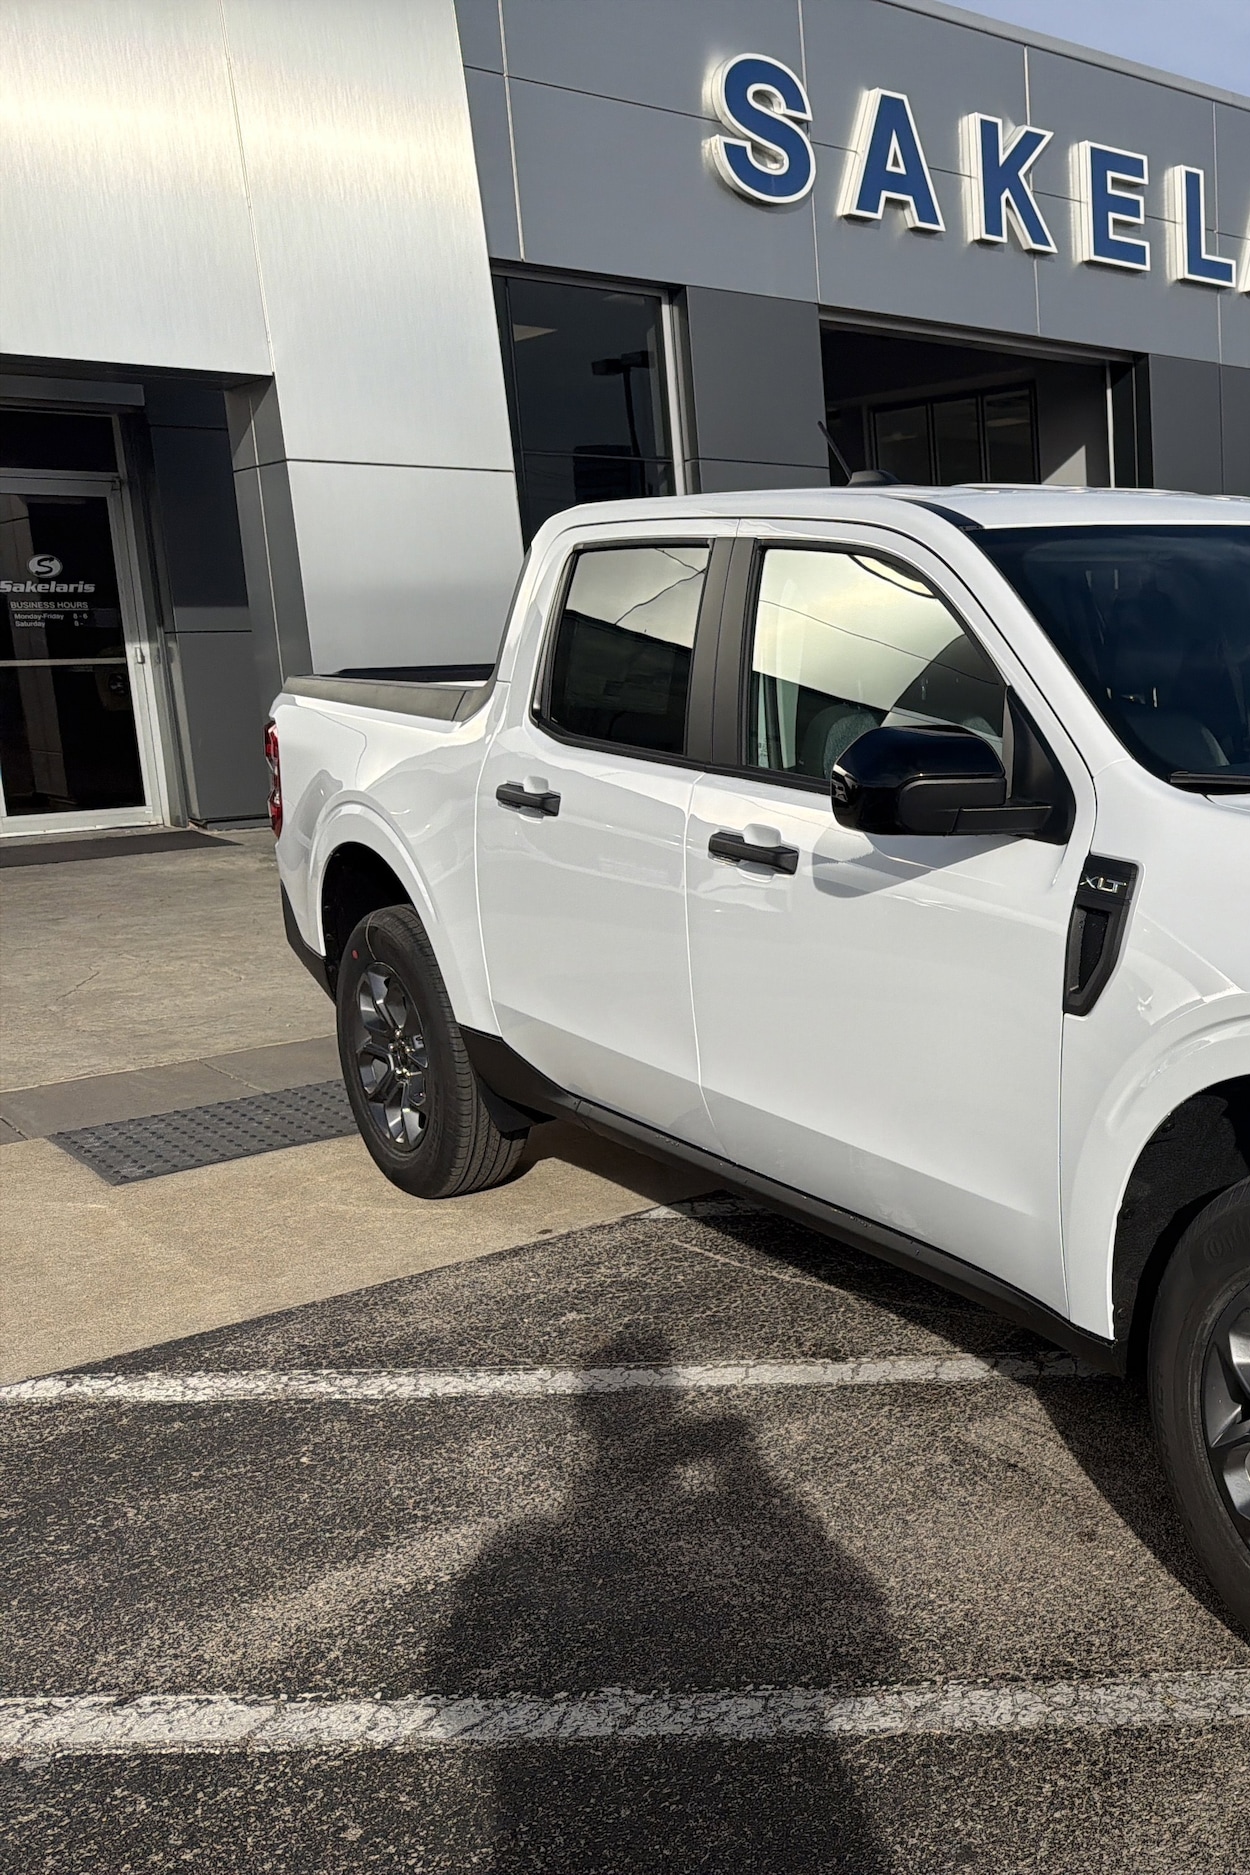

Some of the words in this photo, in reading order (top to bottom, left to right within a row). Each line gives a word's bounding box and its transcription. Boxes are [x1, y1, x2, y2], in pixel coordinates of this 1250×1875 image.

[0, 580, 96, 593] Sakelaris
[10, 601, 55, 609] BUSINESS
[57, 601, 89, 609] HOURS
[14, 613, 64, 621] Monday-Friday
[15, 620, 46, 628] Saturday
